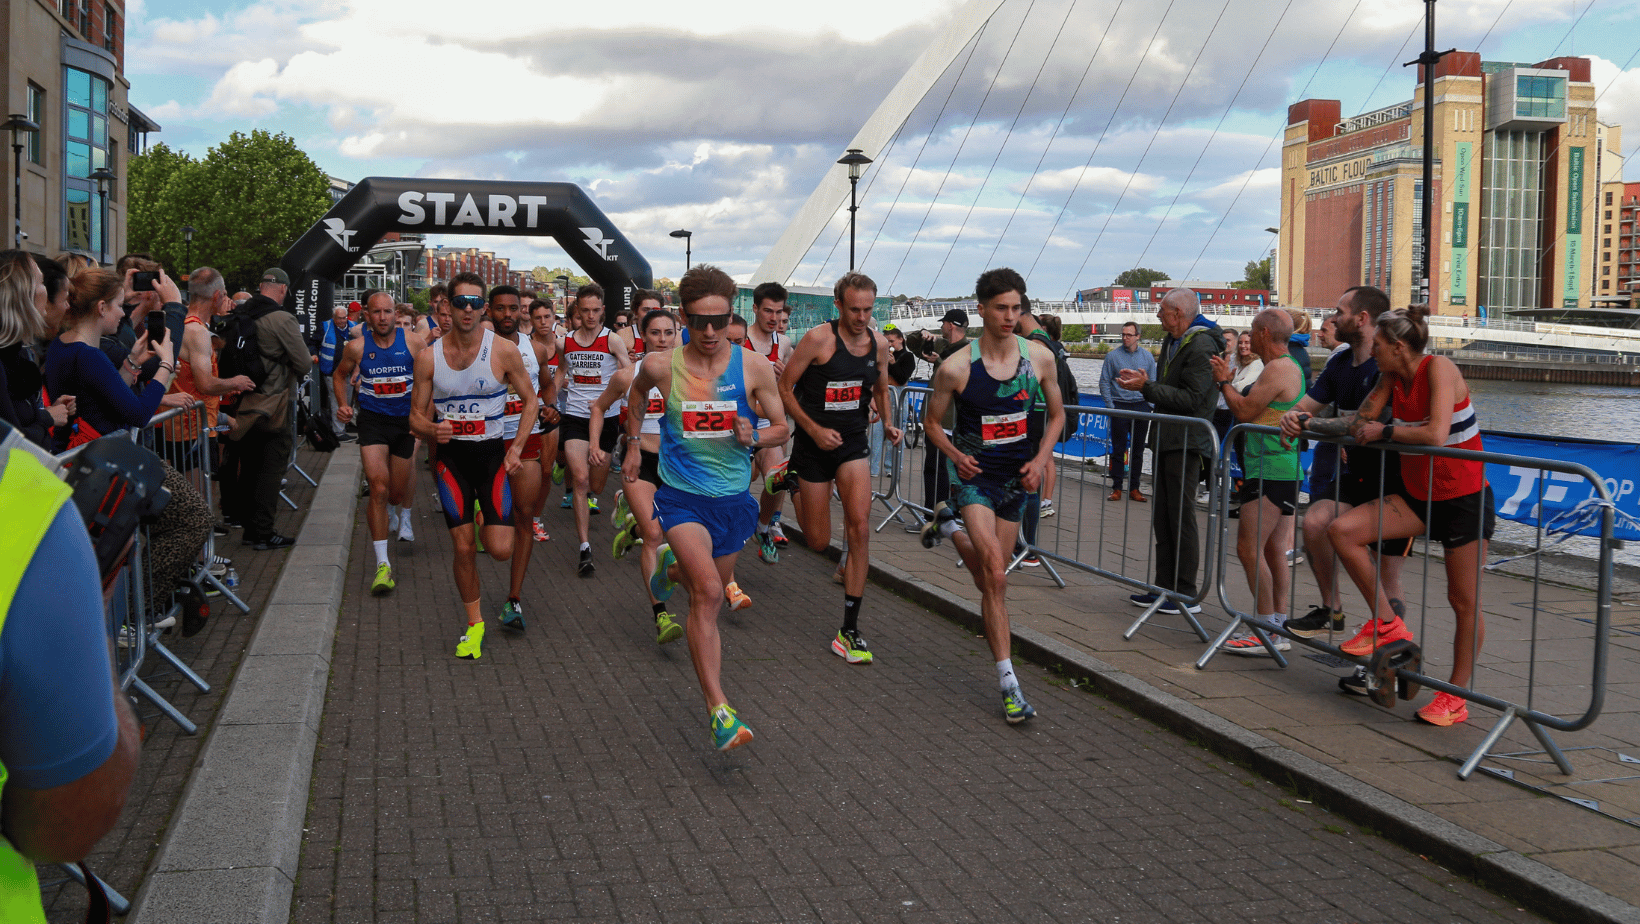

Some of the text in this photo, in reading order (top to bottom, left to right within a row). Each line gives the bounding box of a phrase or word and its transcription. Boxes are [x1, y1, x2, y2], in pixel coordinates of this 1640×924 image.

[1310, 166, 1338, 187] BALTIC
[397, 191, 547, 228] START
[1454, 268, 1463, 288] Entry
[569, 353, 605, 361] GATESHEAD
[368, 365, 407, 375] MORPETH
[571, 361, 602, 369] HARRIERS
[716, 383, 737, 393] HOKA
[832, 388, 856, 402] 181
[457, 403, 468, 414] &
[469, 402, 480, 414] C
[704, 403, 714, 411] 5K
[452, 421, 476, 434] 30
[695, 412, 725, 430] 22
[994, 423, 1018, 438] 23
